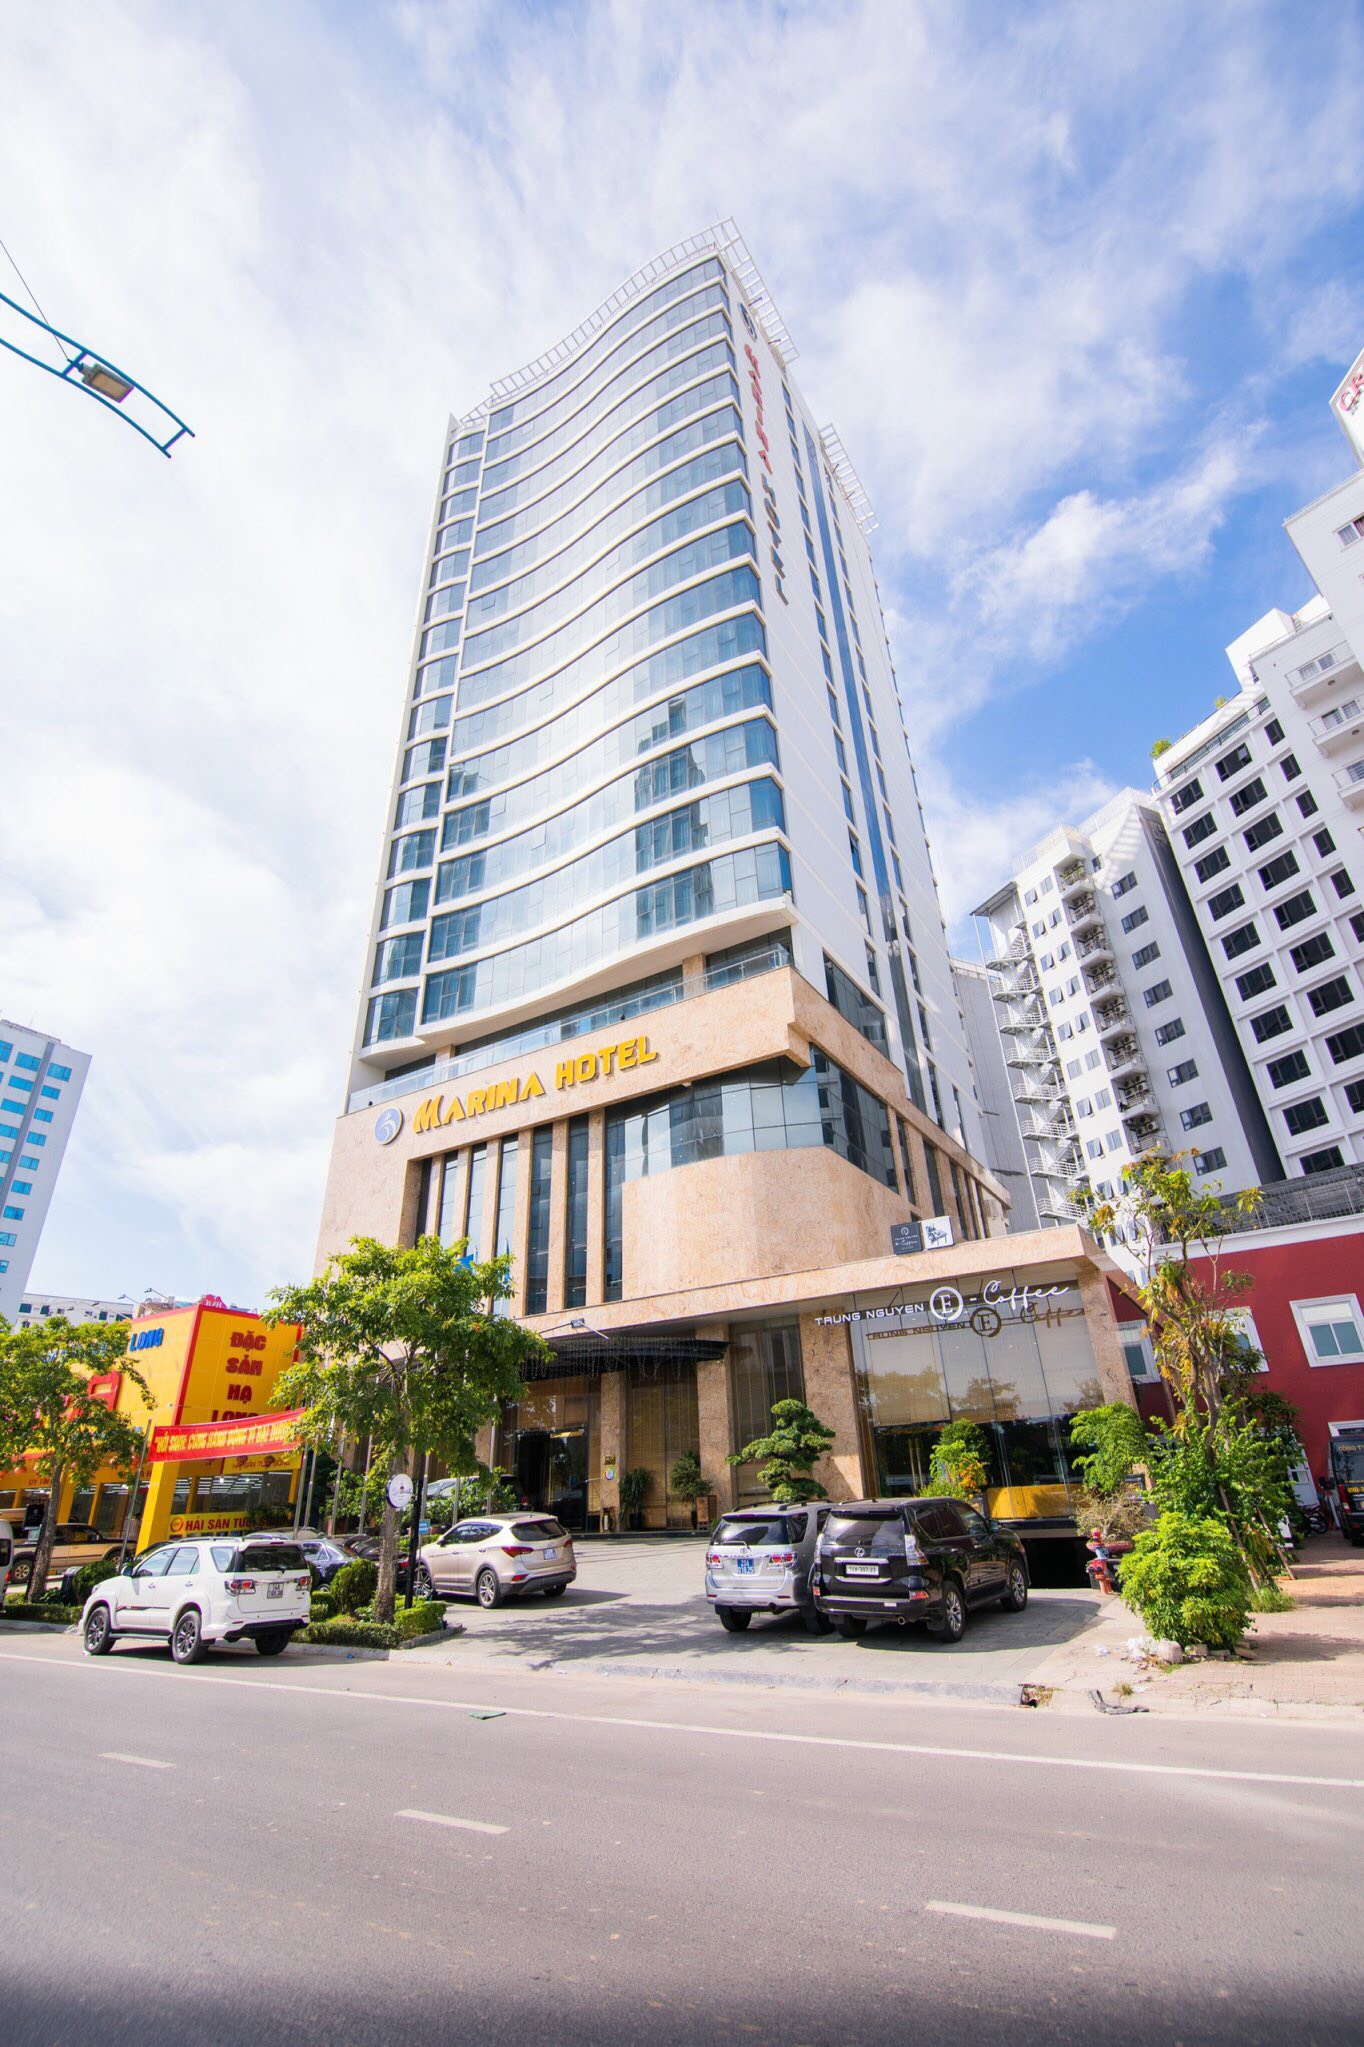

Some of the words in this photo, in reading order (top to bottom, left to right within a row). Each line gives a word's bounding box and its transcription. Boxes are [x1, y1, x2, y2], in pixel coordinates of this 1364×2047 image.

[412, 1071, 546, 1134] MARINA
[555, 1035, 659, 1089] HOTEL
[815, 1312, 861, 1326] TRUNG
[867, 1302, 925, 1320] NGUYEN
[983, 1280, 1070, 1311] Coffee
[130, 1328, 164, 1352] LONG
[230, 1330, 267, 1351] ĐẶC
[226, 1354, 263, 1376] SẢN
[227, 1384, 252, 1404] HẠ
[185, 1516, 205, 1531] HẢI
[208, 1514, 230, 1529] SẢN
